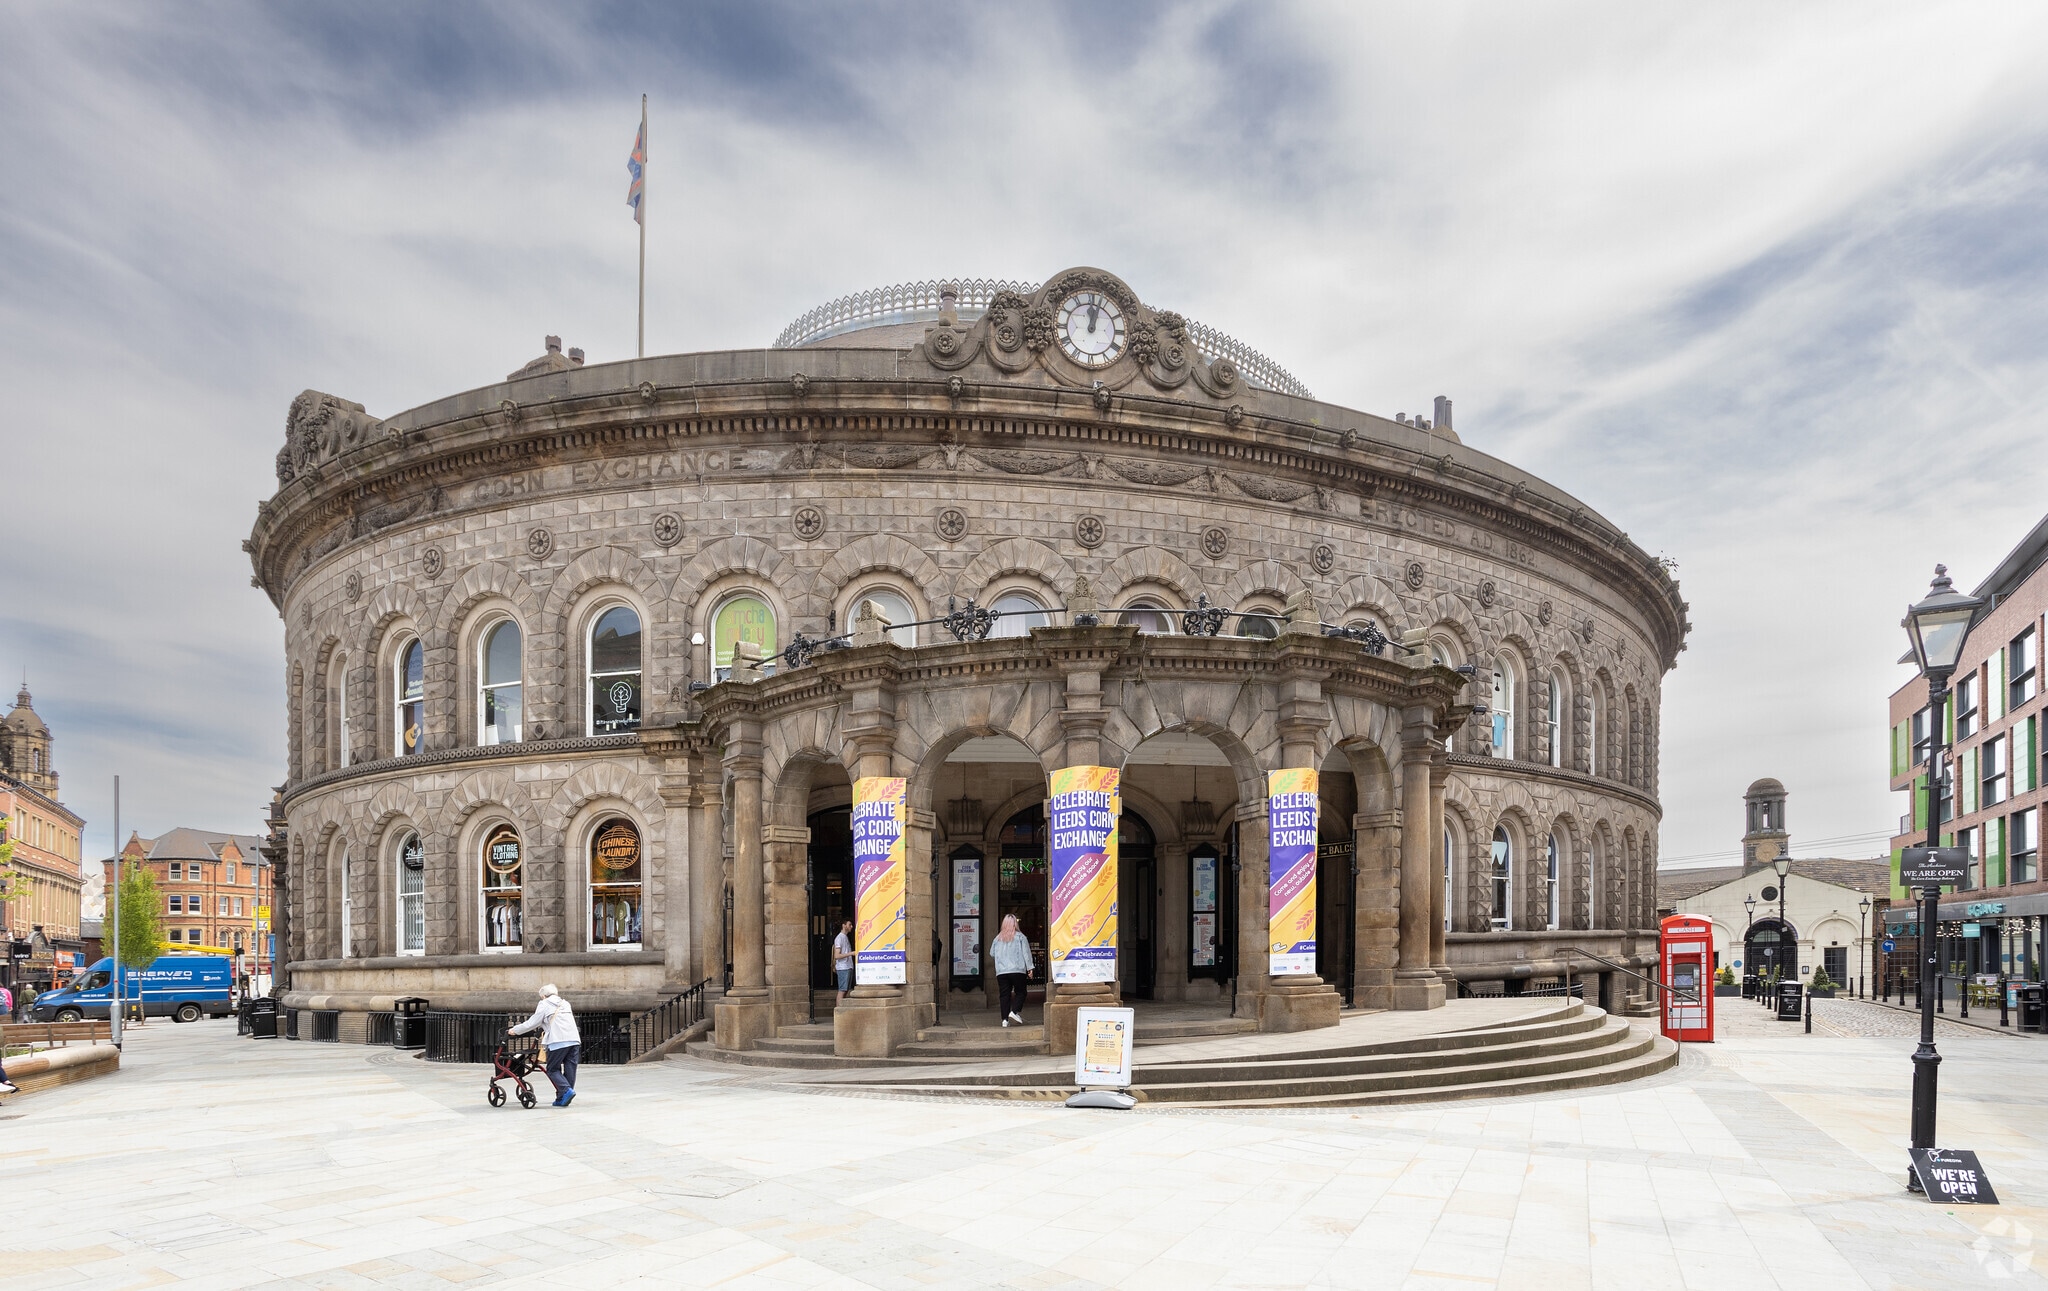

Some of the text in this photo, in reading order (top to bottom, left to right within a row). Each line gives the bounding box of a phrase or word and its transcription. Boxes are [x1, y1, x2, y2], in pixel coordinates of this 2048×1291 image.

[474, 450, 749, 502] CORN EXCHANGE
[726, 624, 765, 647] gallery
[1053, 790, 1111, 811] CELEBRATE
[868, 820, 901, 836] CORN
[1053, 810, 1115, 831] LEEDS CORN
[1272, 811, 1310, 828] LEEDS
[493, 843, 518, 853] VINTAGE
[601, 837, 636, 848] CHINESE
[1054, 829, 1107, 850] EXCHANGE
[493, 851, 519, 860] CLOTHING
[601, 847, 636, 858] LAUNDRY
[1056, 857, 1093, 901] Come and enjoy our
[1070, 872, 1088, 890] outside
[1086, 858, 1100, 874] space!
[1273, 883, 1289, 897] Come
[1287, 873, 1298, 884] and
[1296, 862, 1310, 875] enjoy
[1295, 869, 1311, 886] outside
[1937, 869, 1964, 877] OPEN
[1931, 1169, 1978, 1182] WE'RE
[1940, 1181, 1978, 1195] OPEN
